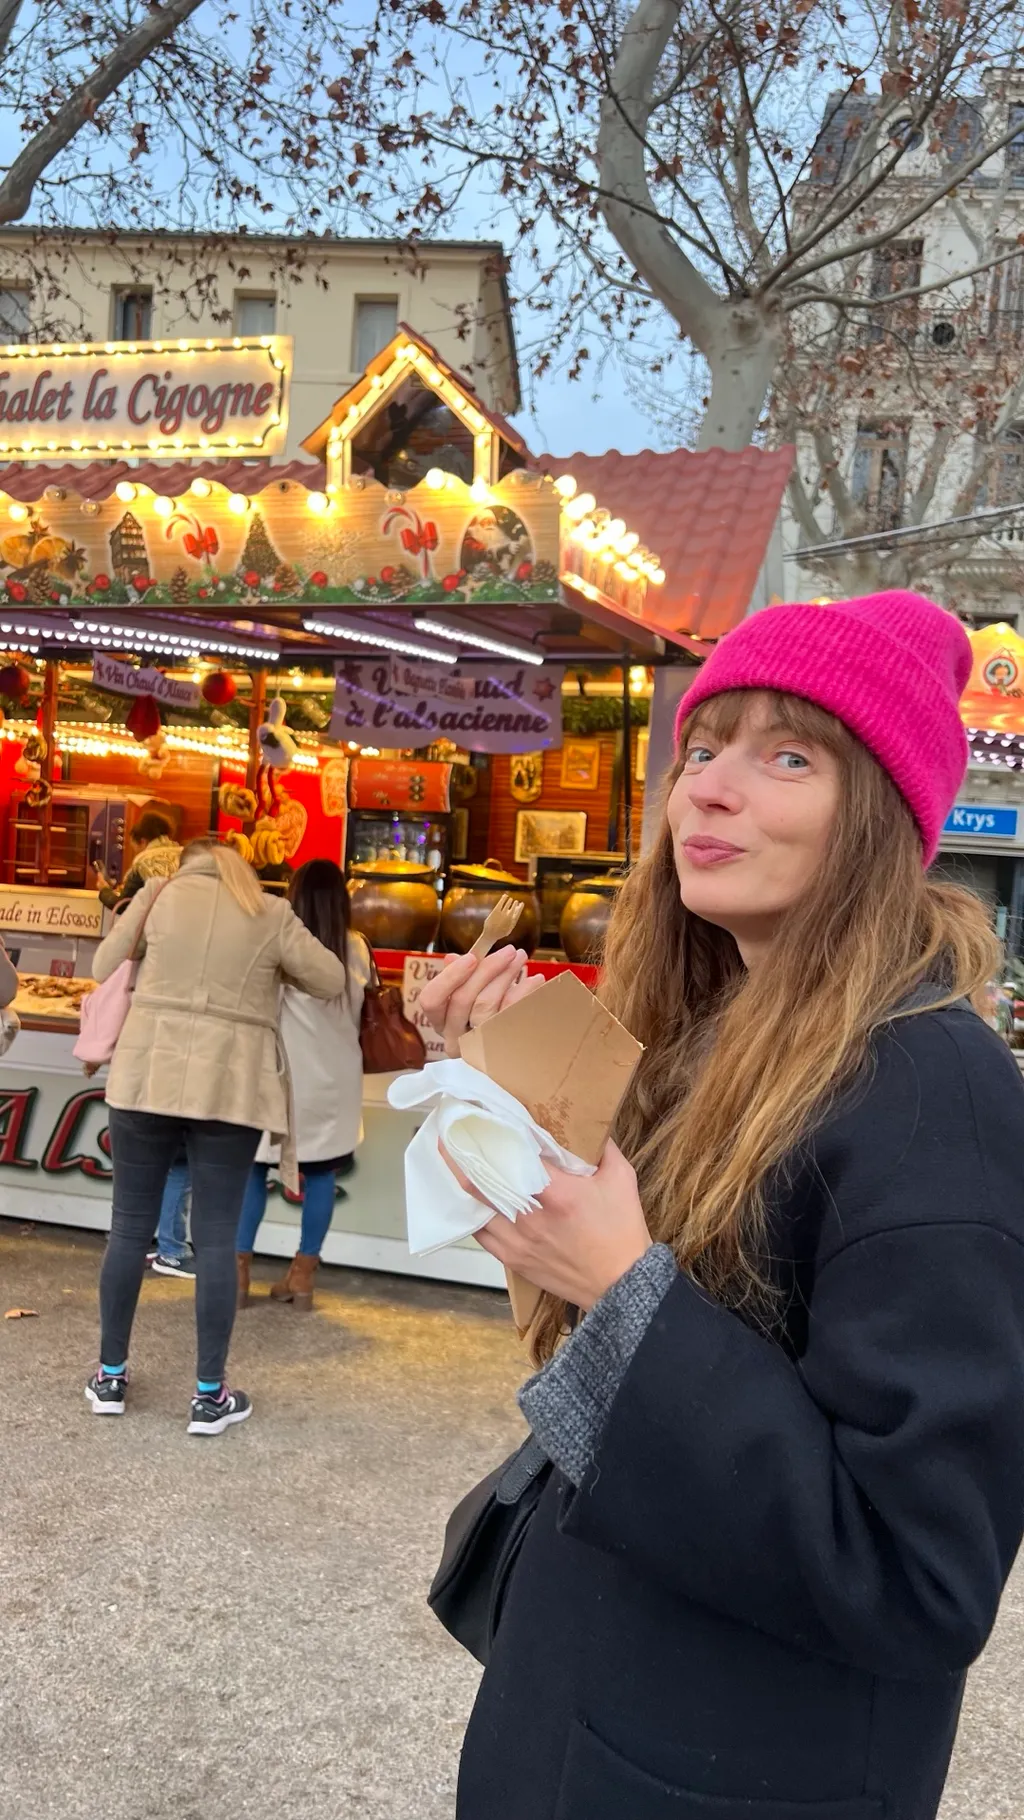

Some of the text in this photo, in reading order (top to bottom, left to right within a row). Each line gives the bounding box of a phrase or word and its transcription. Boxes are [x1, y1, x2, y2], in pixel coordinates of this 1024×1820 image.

[82, 368, 118, 421] la
[128, 370, 275, 435] Cigogne
[345, 700, 549, 733] à l'alsacienne
[953, 808, 996, 832] Krys
[27, 904, 41, 924] in
